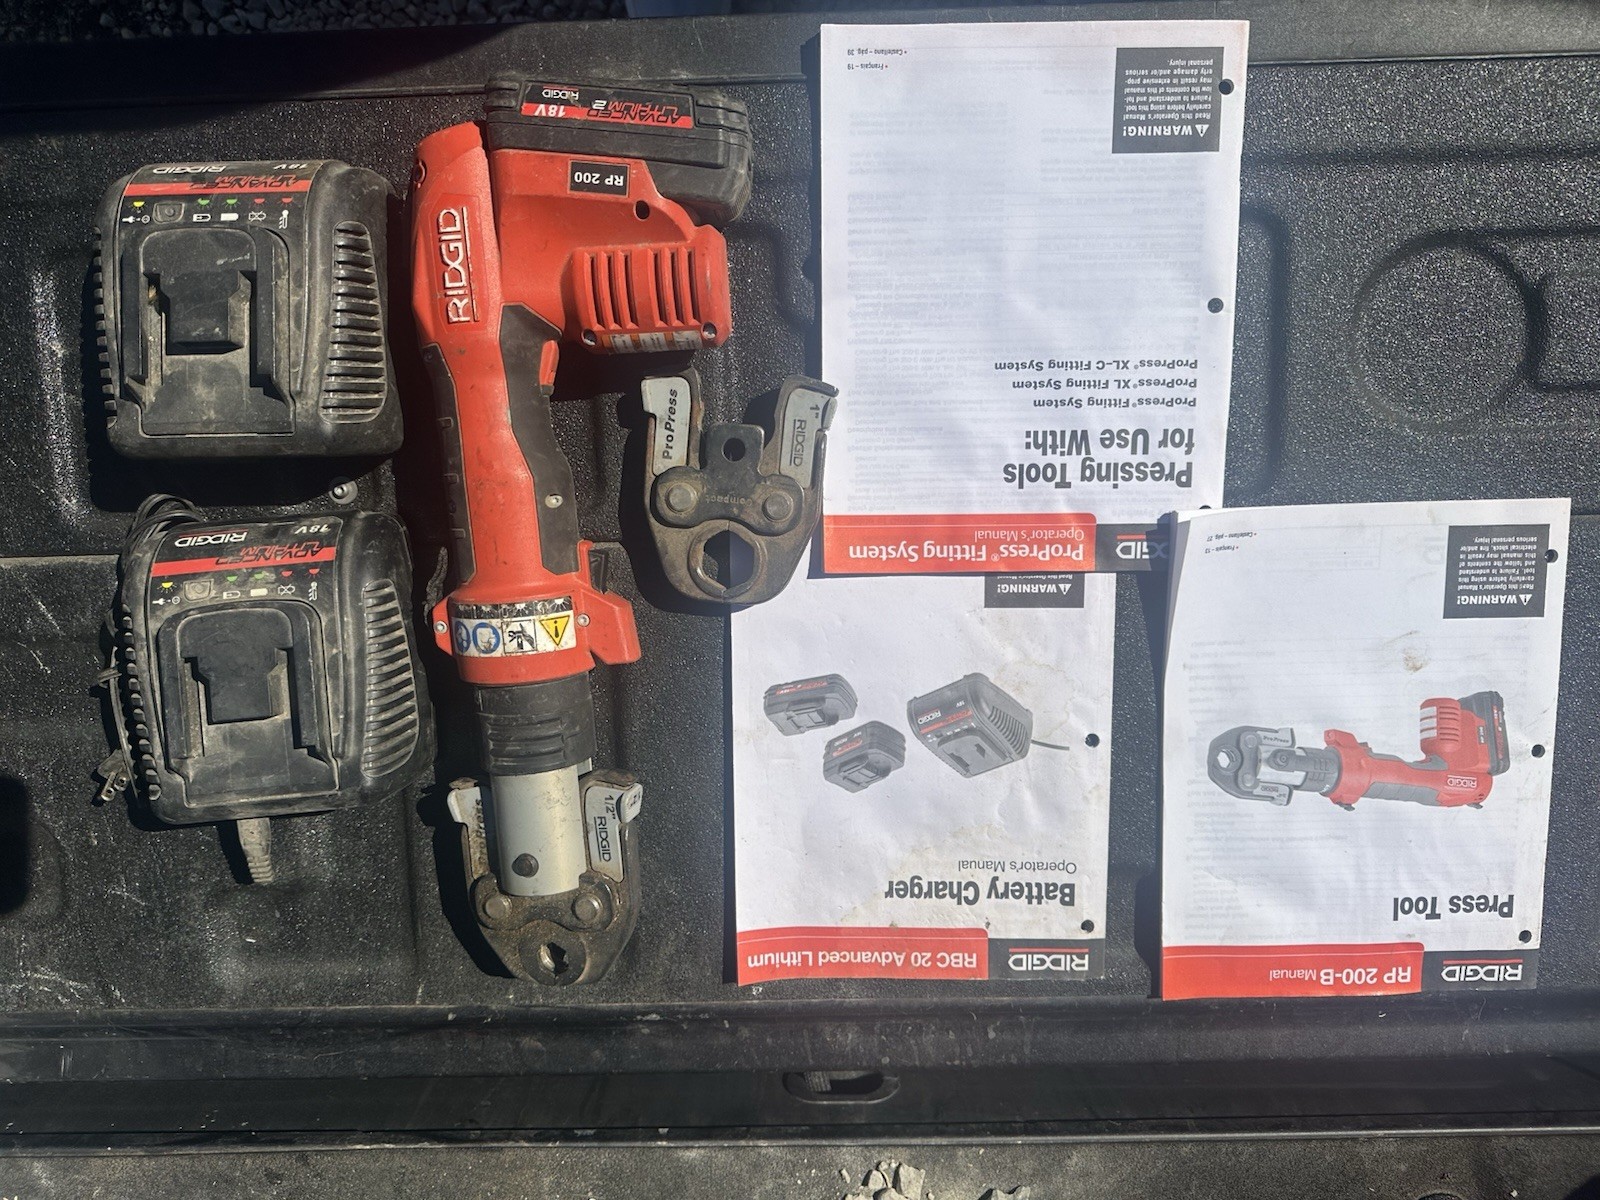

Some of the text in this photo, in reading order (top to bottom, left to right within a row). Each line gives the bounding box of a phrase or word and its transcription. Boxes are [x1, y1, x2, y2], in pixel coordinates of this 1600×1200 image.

[860, 62, 884, 70] Français
[1167, 58, 1213, 67] personal injury.
[1173, 68, 1198, 76] damage
[1200, 67, 1213, 75] erty
[1125, 77, 1141, 85] prop-
[1199, 76, 1212, 84] may
[542, 88, 579, 99] RIDGID
[1166, 86, 1190, 94] contents
[534, 104, 566, 117] 18V
[607, 101, 678, 117] LITHIUM
[1150, 103, 1166, 111] using
[1186, 103, 1211, 111] carefully
[586, 108, 681, 125] ADVANCED
[1148, 112, 1179, 120] Operator's
[1122, 125, 1192, 136] WARNING!
[152, 165, 227, 174] RIDGID
[574, 171, 624, 186] RP 200
[439, 208, 470, 323] RIDGID
[994, 360, 1040, 373] System
[1043, 358, 1091, 372] Fitting
[1012, 378, 1063, 391] System
[1066, 377, 1109, 391] Fitting
[1113, 378, 1131, 390] XL
[1032, 396, 1083, 410] System
[1086, 395, 1130, 409] Fitting
[809, 404, 820, 419] 1"
[662, 388, 678, 460] ProPress
[793, 419, 807, 467] RIDGID
[1024, 428, 1195, 457] for Use With:
[1003, 457, 1193, 490] Pressing Tools
[294, 524, 331, 534] 18V
[974, 527, 1085, 542] Operator's Manual
[174, 531, 248, 547] RIDGID
[240, 541, 320, 556] LITHIUM
[849, 541, 919, 562] System
[922, 541, 987, 562] Fitting
[215, 547, 323, 565] ADVANCED
[997, 584, 1057, 593] WARNING!
[1457, 595, 1517, 604] WARNING!
[1447, 777, 1477, 788] RIDGID
[604, 795, 615, 820] 1/2"
[597, 816, 611, 862] RIDGID
[958, 860, 1077, 874] Operator's Manual
[884, 875, 1075, 906] Battery Charger
[1393, 894, 1514, 921] Press Tool
[747, 951, 977, 968] RBC 20 Advanced Lithium
[1008, 953, 1089, 971] RIDGID
[1269, 966, 1411, 985] RP 200-B Manual
[1441, 964, 1523, 981] RIDGID
